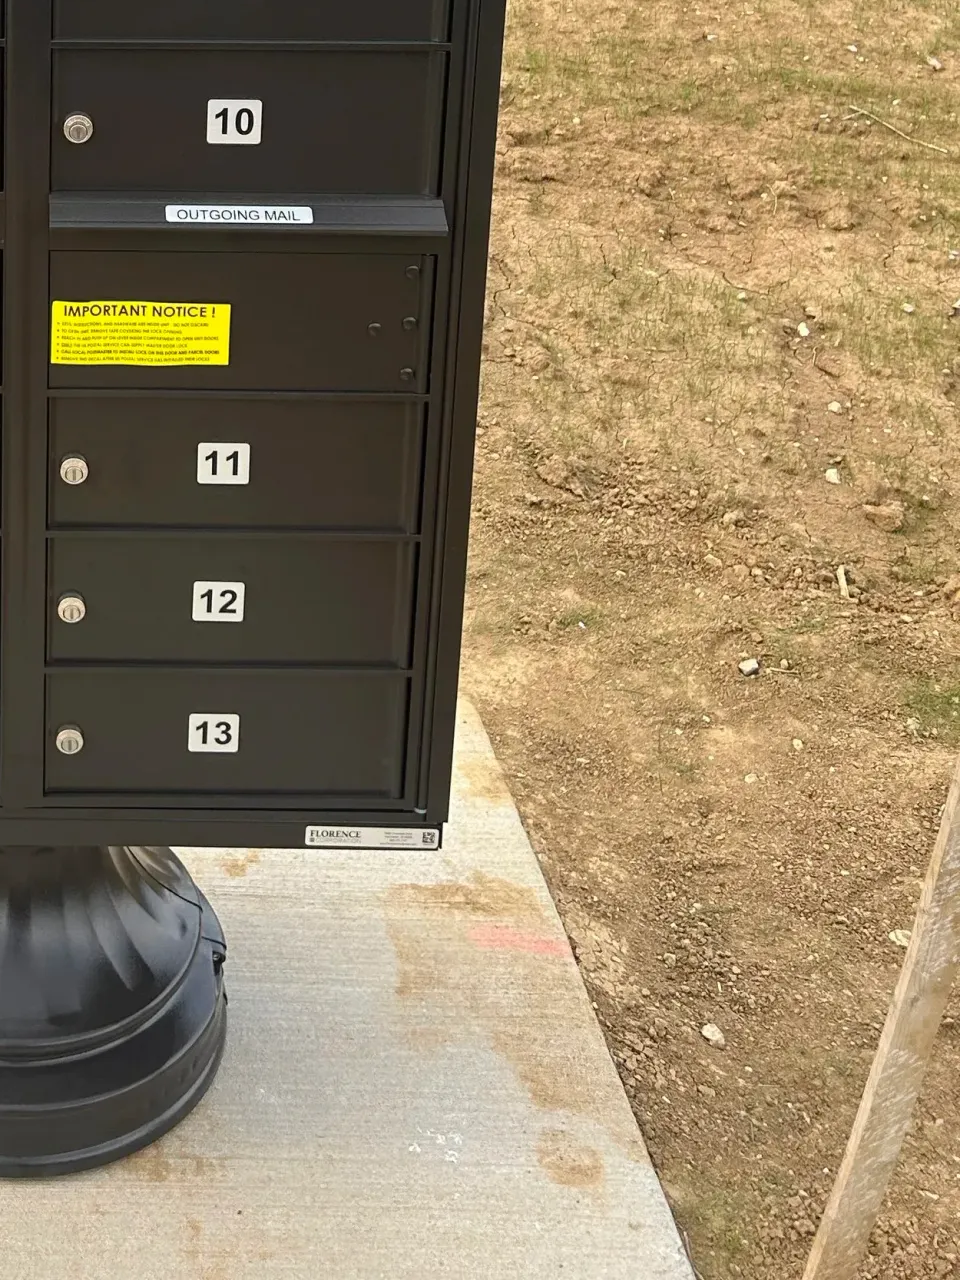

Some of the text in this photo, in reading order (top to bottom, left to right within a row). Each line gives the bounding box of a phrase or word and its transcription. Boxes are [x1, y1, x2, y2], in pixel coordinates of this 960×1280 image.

[215, 108, 253, 135] 10
[177, 209, 300, 221] OUTGOING MAIL
[64, 304, 216, 318] IMPORTANT NOTICE !
[206, 451, 238, 475] 11
[201, 590, 237, 613] 12
[196, 722, 231, 744] 13
[310, 830, 362, 838] FLORENCE
